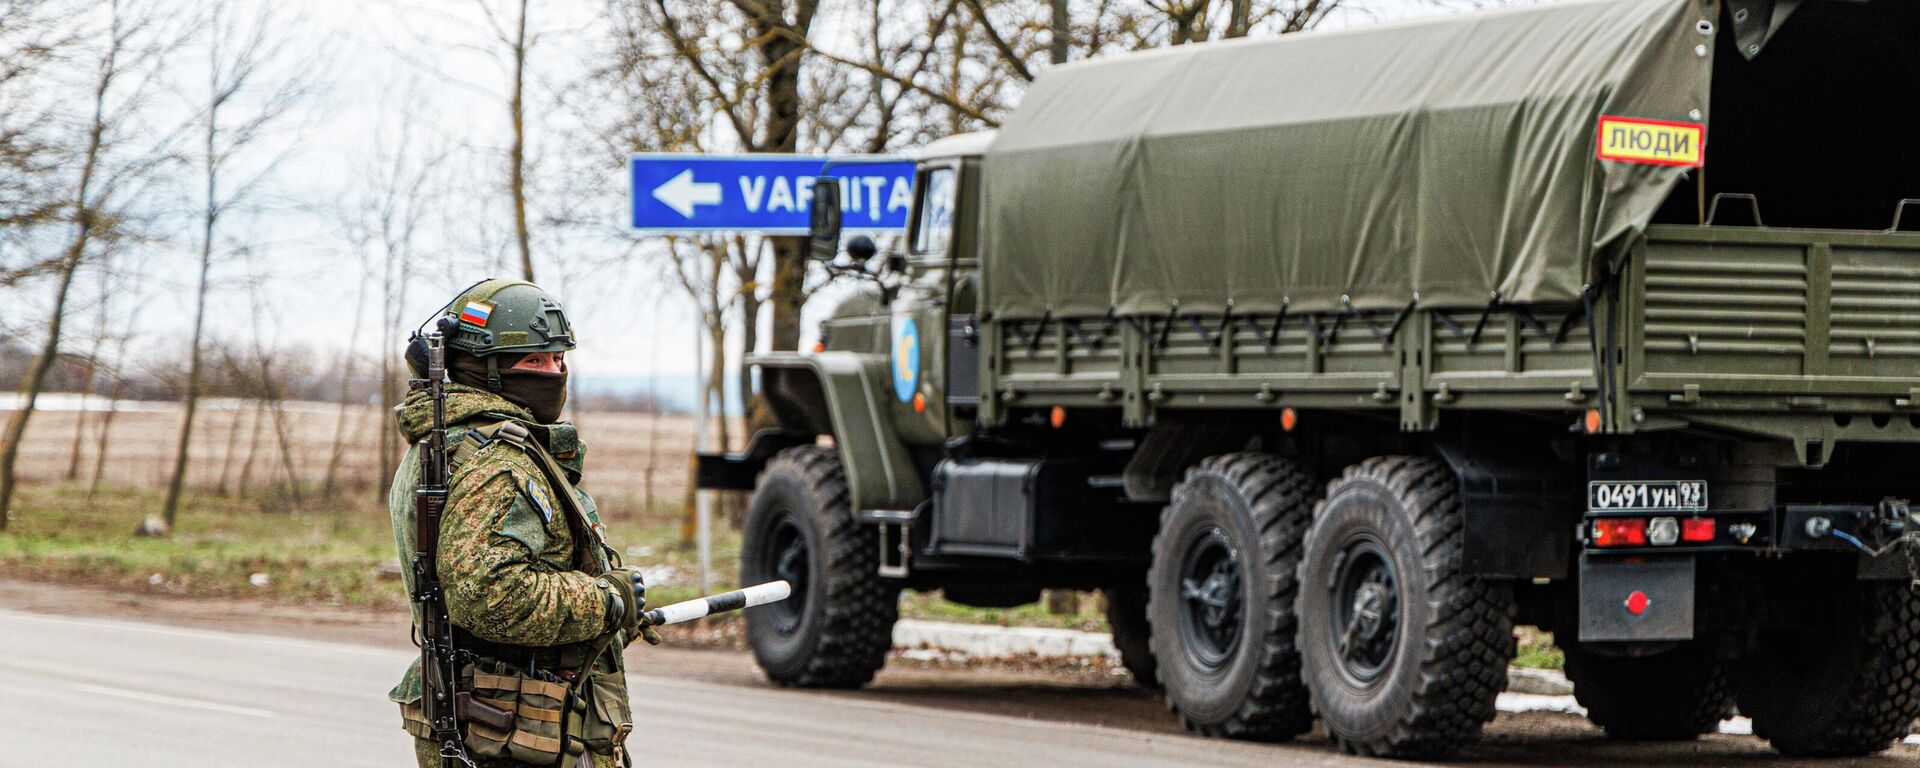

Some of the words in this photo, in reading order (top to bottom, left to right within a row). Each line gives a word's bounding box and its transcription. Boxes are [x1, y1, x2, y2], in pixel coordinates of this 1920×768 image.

[1610, 128, 1690, 156] ЛЮДИ
[1597, 484, 1648, 508] 0491
[1681, 483, 1701, 501] 93
